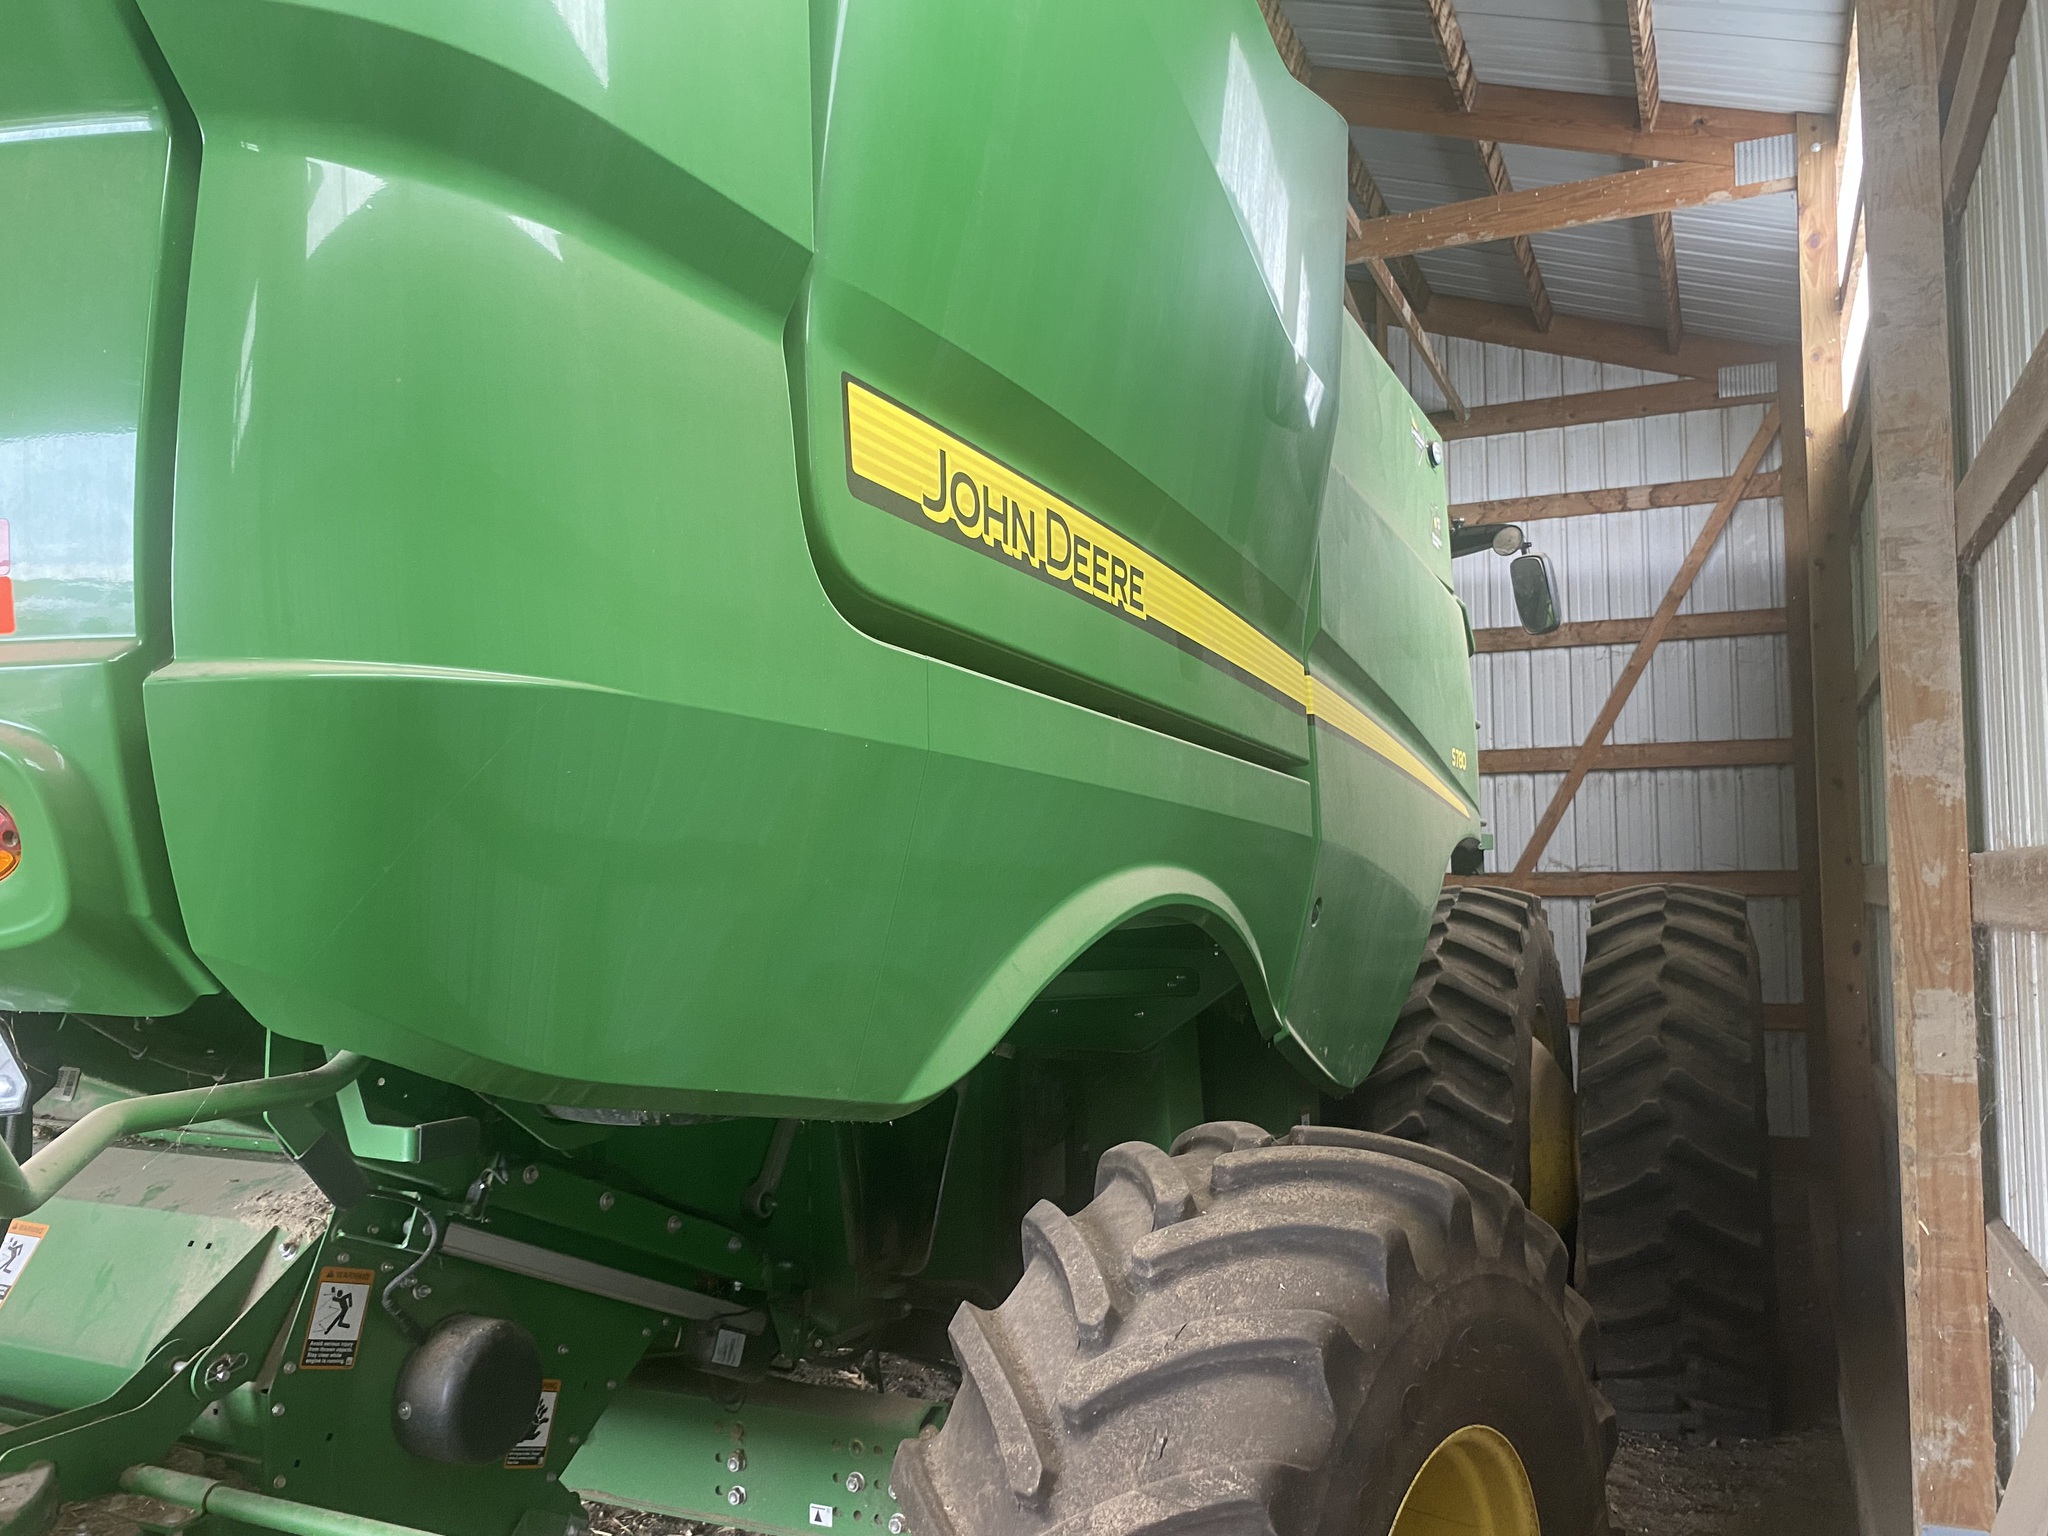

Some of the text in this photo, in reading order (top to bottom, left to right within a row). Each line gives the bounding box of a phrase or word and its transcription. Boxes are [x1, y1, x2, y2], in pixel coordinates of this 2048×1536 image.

[922, 448, 1146, 614] JOHN DEERE
[1451, 747, 1467, 770] S780
[336, 1271, 370, 1280] WARNING
